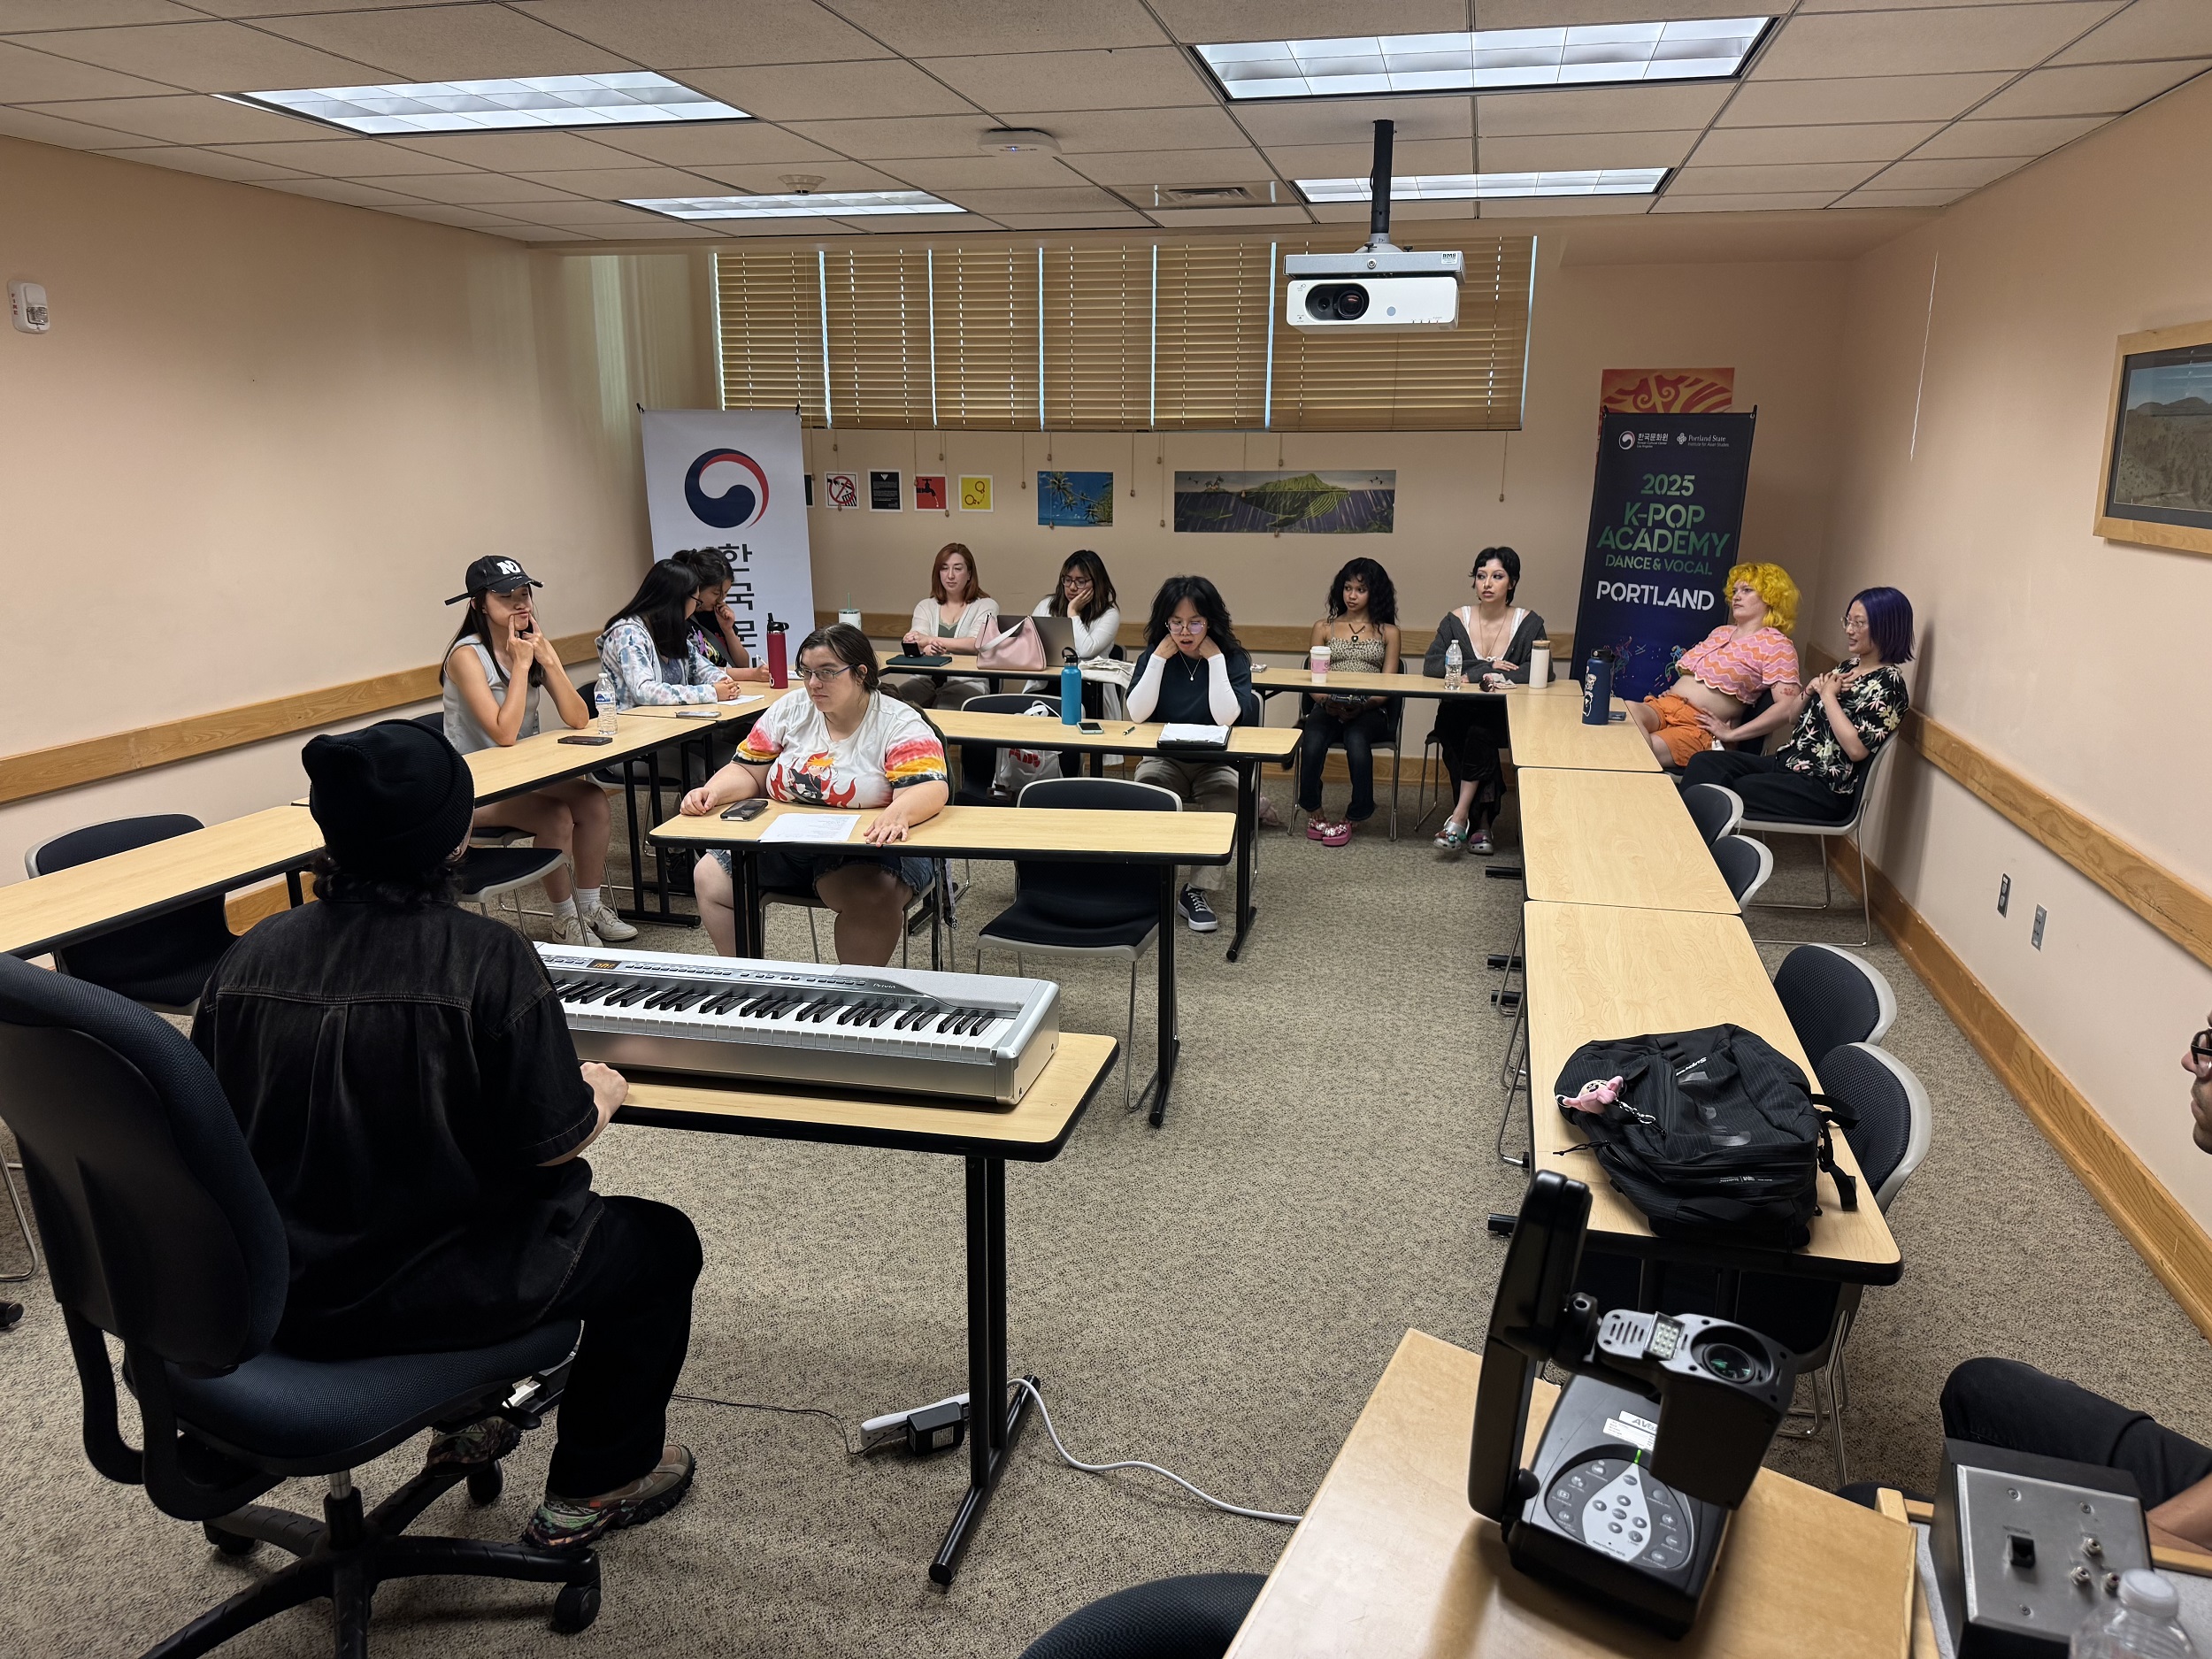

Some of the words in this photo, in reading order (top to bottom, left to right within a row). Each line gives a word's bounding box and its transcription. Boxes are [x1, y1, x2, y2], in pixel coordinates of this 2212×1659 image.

[1640, 472, 1695, 496] 2025
[1624, 502, 1706, 529] K-POP
[1596, 526, 1731, 557] ACADEMY
[1605, 554, 1652, 570] DANCE
[1652, 558, 1662, 571] &
[1663, 558, 1713, 575] VOCAL
[1596, 580, 1715, 611] PORTLAND
[876, 995, 905, 1004] PX-310
[1632, 1418, 1656, 1432] AVe
